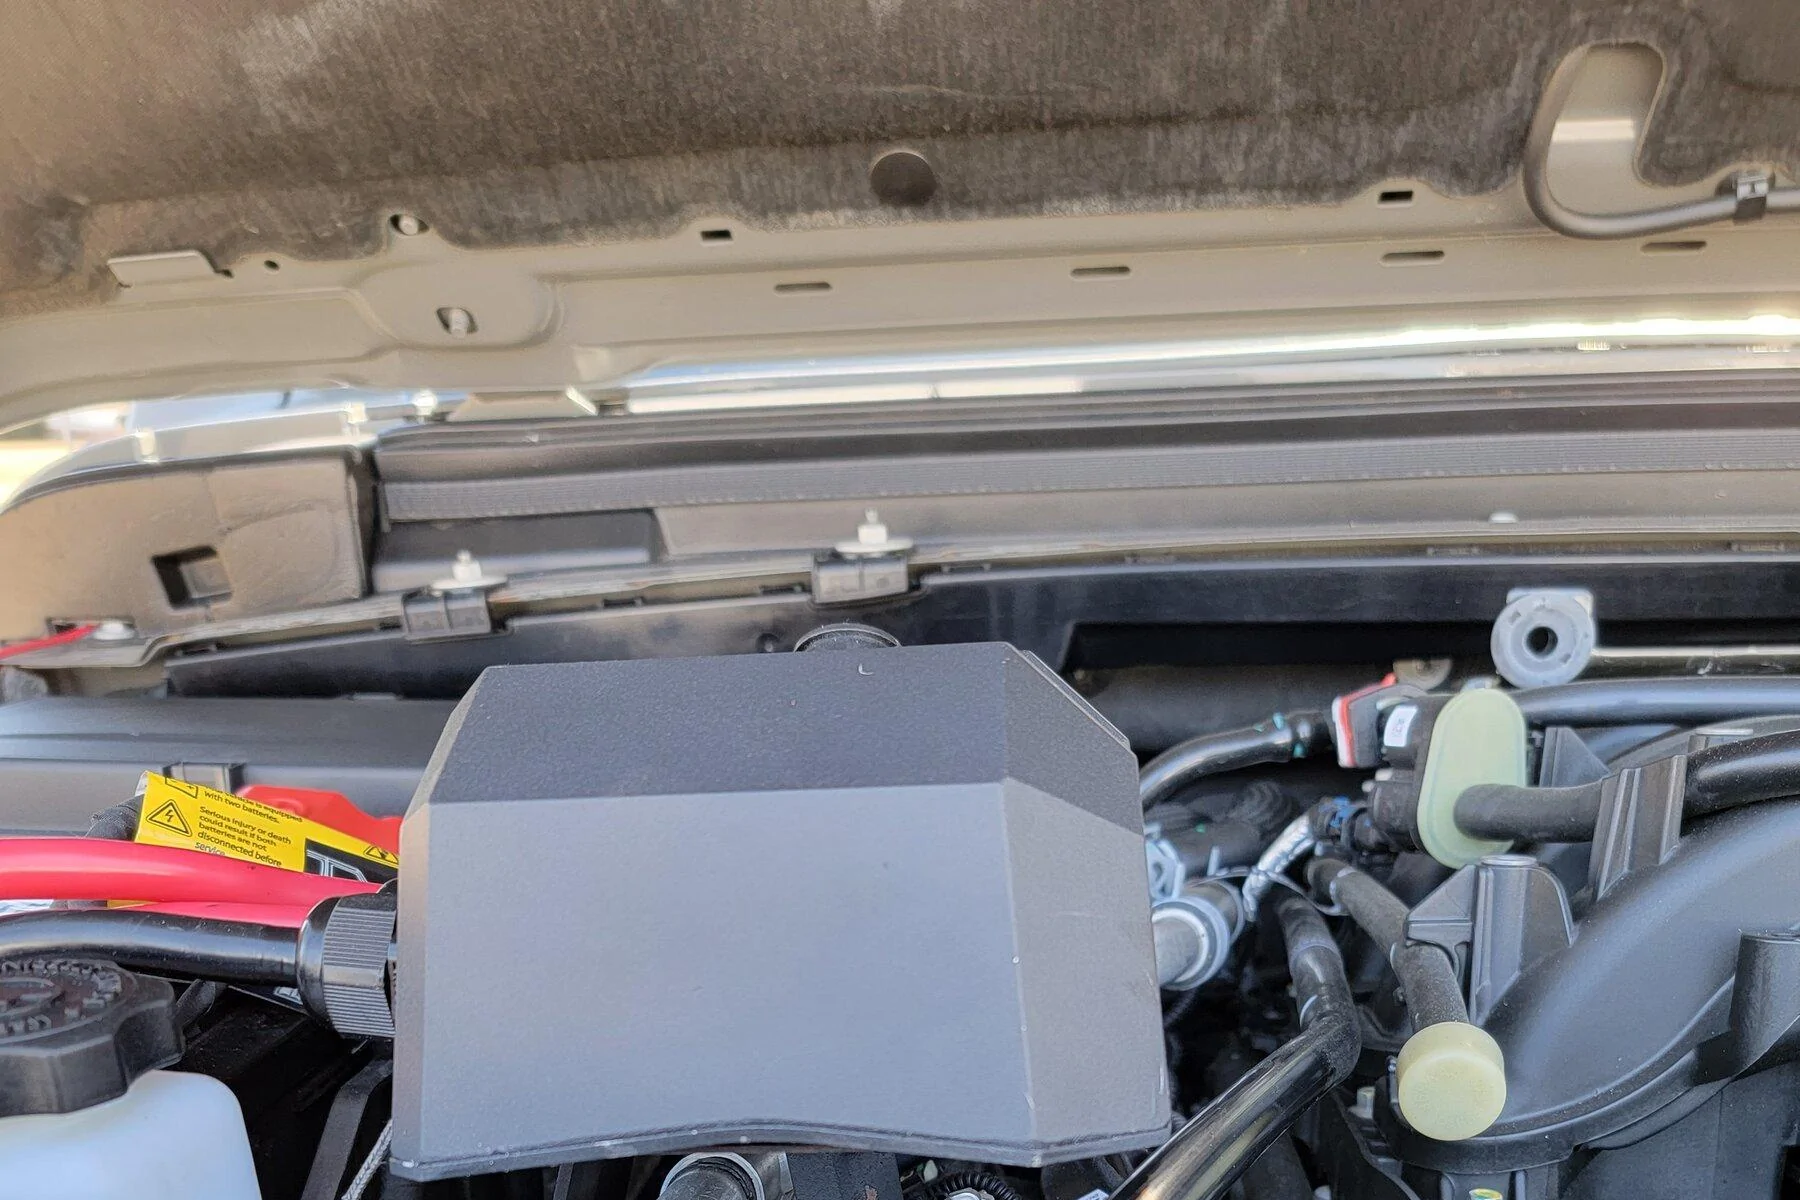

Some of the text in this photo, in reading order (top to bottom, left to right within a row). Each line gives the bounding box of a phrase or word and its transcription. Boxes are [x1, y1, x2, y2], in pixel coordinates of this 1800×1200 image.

[224, 797, 241, 809] two
[198, 822, 268, 852] batteries are not
[199, 806, 292, 845] Serious injury or death
[199, 815, 224, 828] could
[224, 824, 248, 838] result
[256, 834, 277, 847] both
[197, 831, 254, 857] disconnected
[254, 851, 282, 867] before
